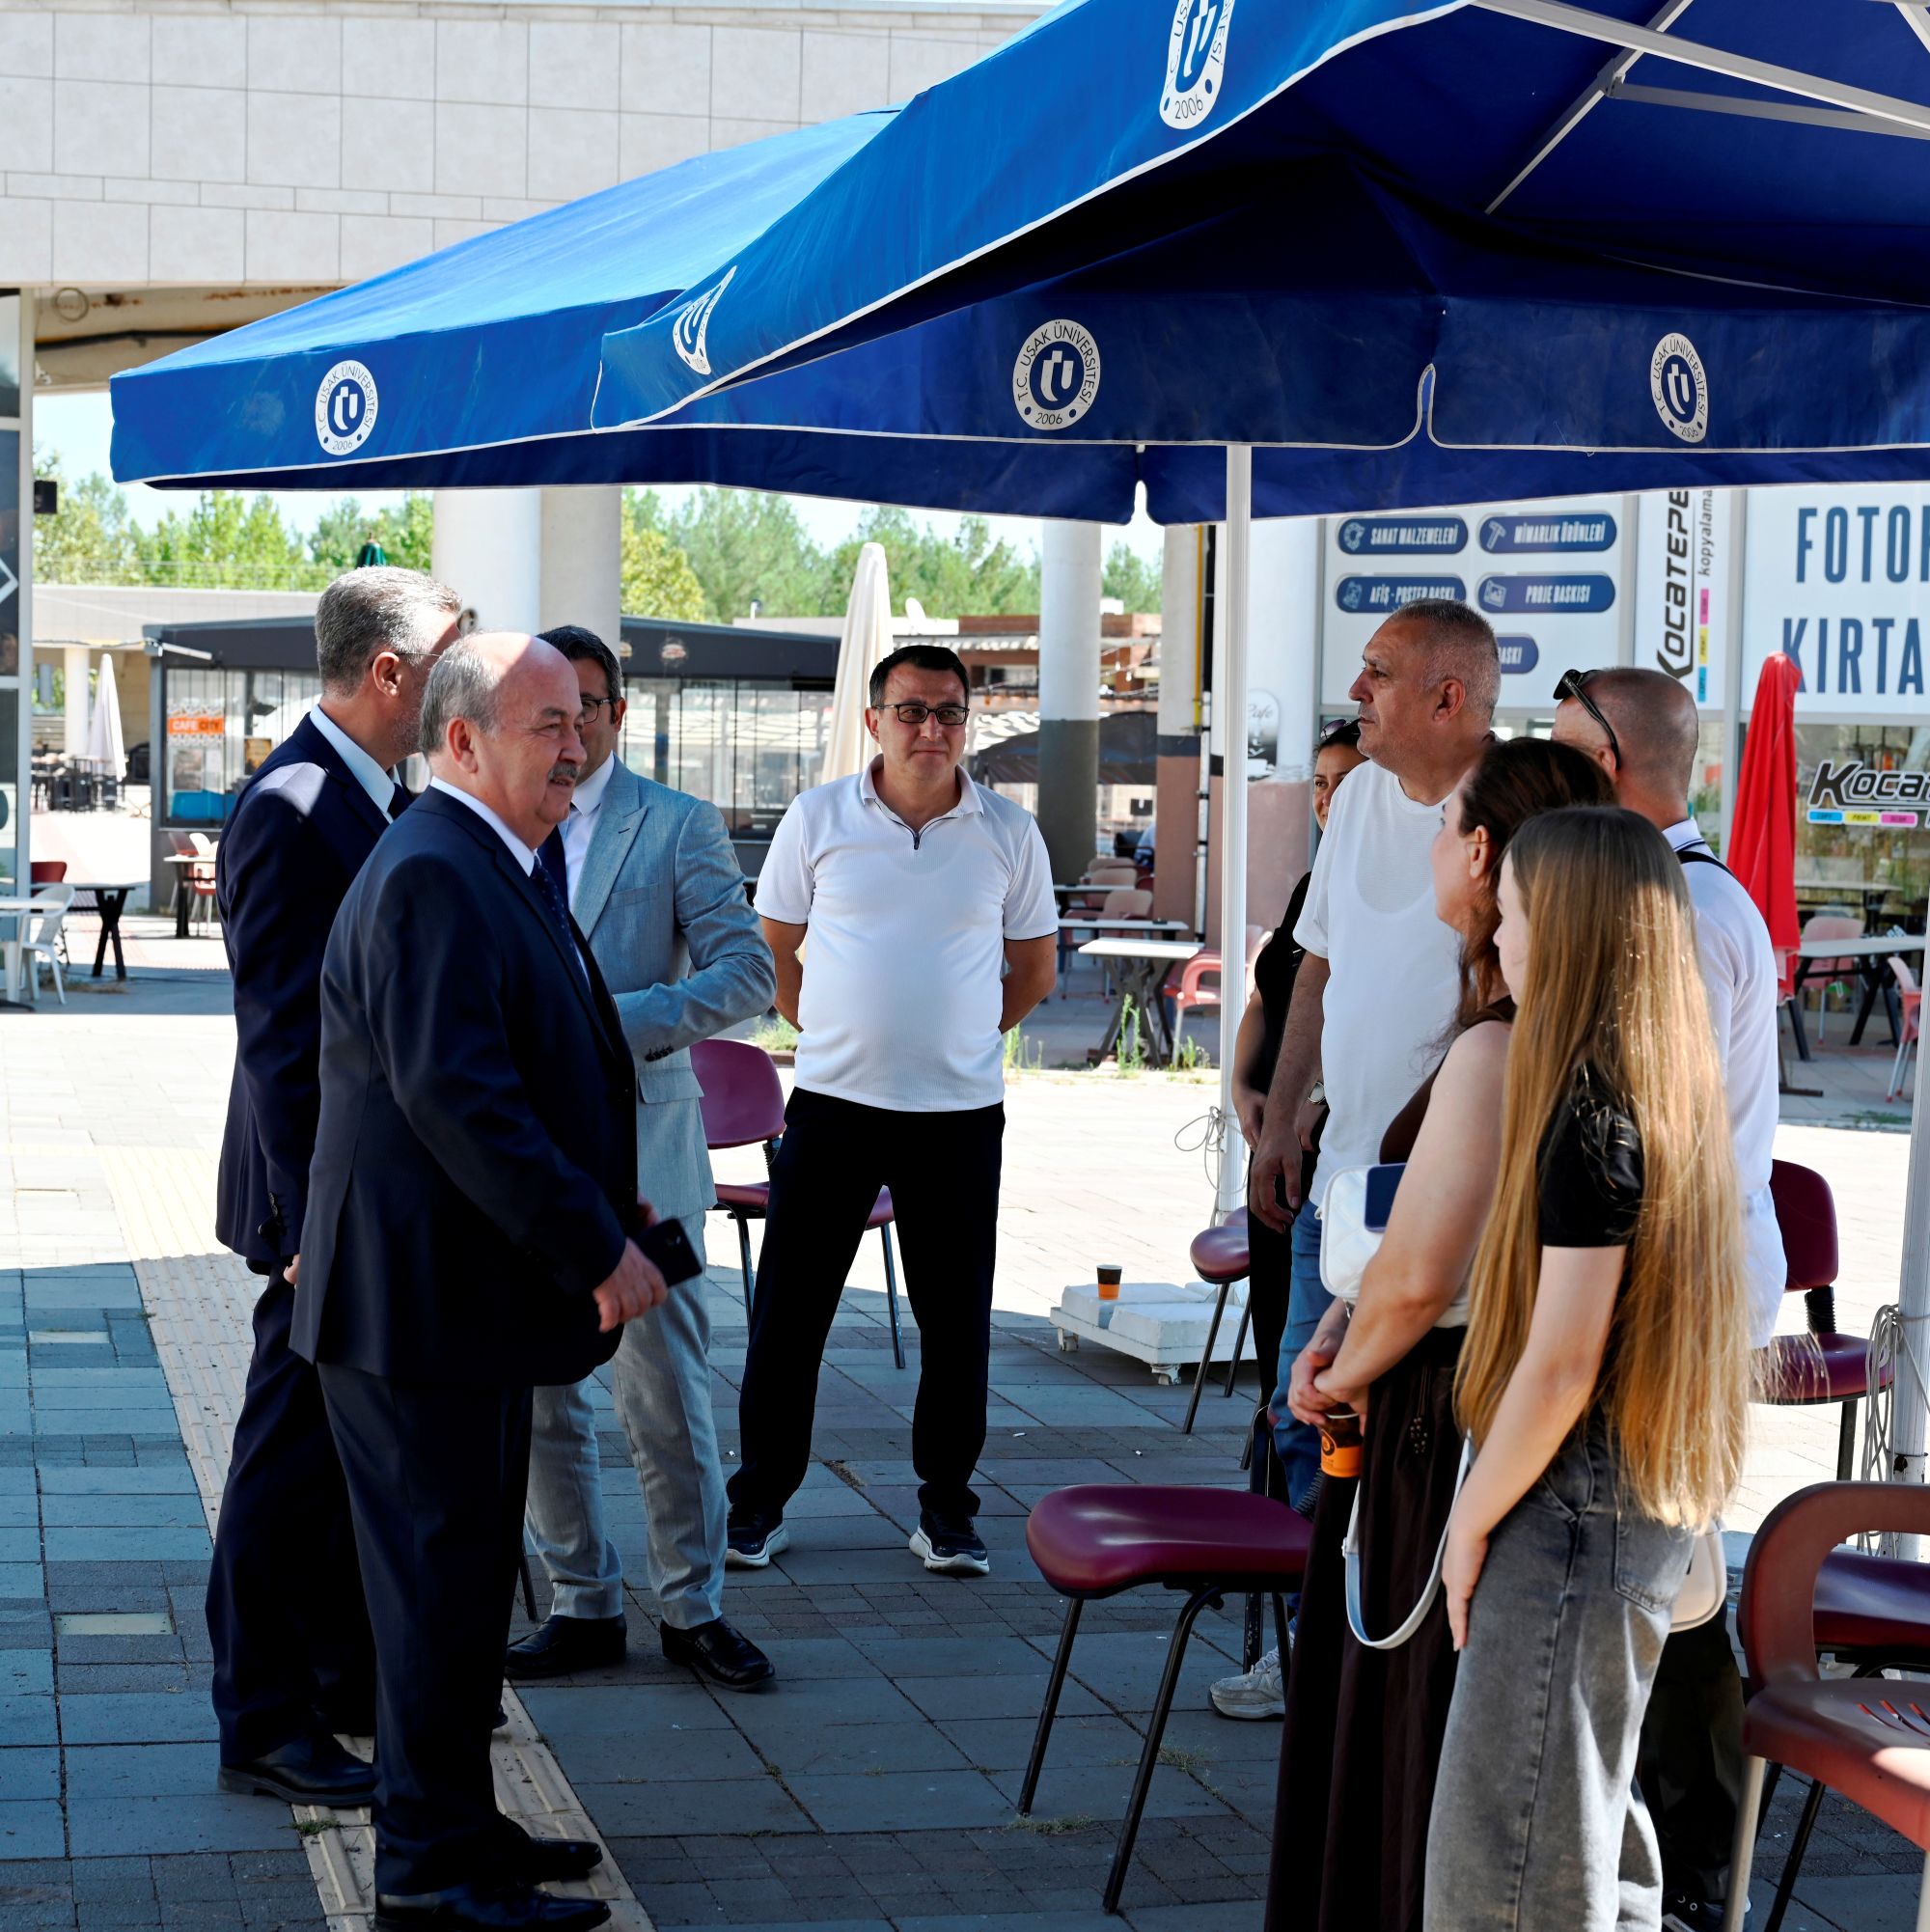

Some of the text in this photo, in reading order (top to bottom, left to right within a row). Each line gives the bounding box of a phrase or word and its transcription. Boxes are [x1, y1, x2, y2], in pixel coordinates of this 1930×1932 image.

[1174, 93, 1203, 120] 2006
[1016, 320, 1100, 406] T.C. UŞAK ÜNİVERSİTESİ
[1034, 412, 1063, 426] 2006
[1371, 524, 1459, 545] SANAT MALZEMELERİ
[1514, 520, 1606, 544] MİMARLIK ÜRÜNLERİ
[1369, 584, 1391, 605] AFİŞ
[1525, 584, 1591, 603] PROJE BASKISI
[1782, 618, 1924, 695] KIRTA
